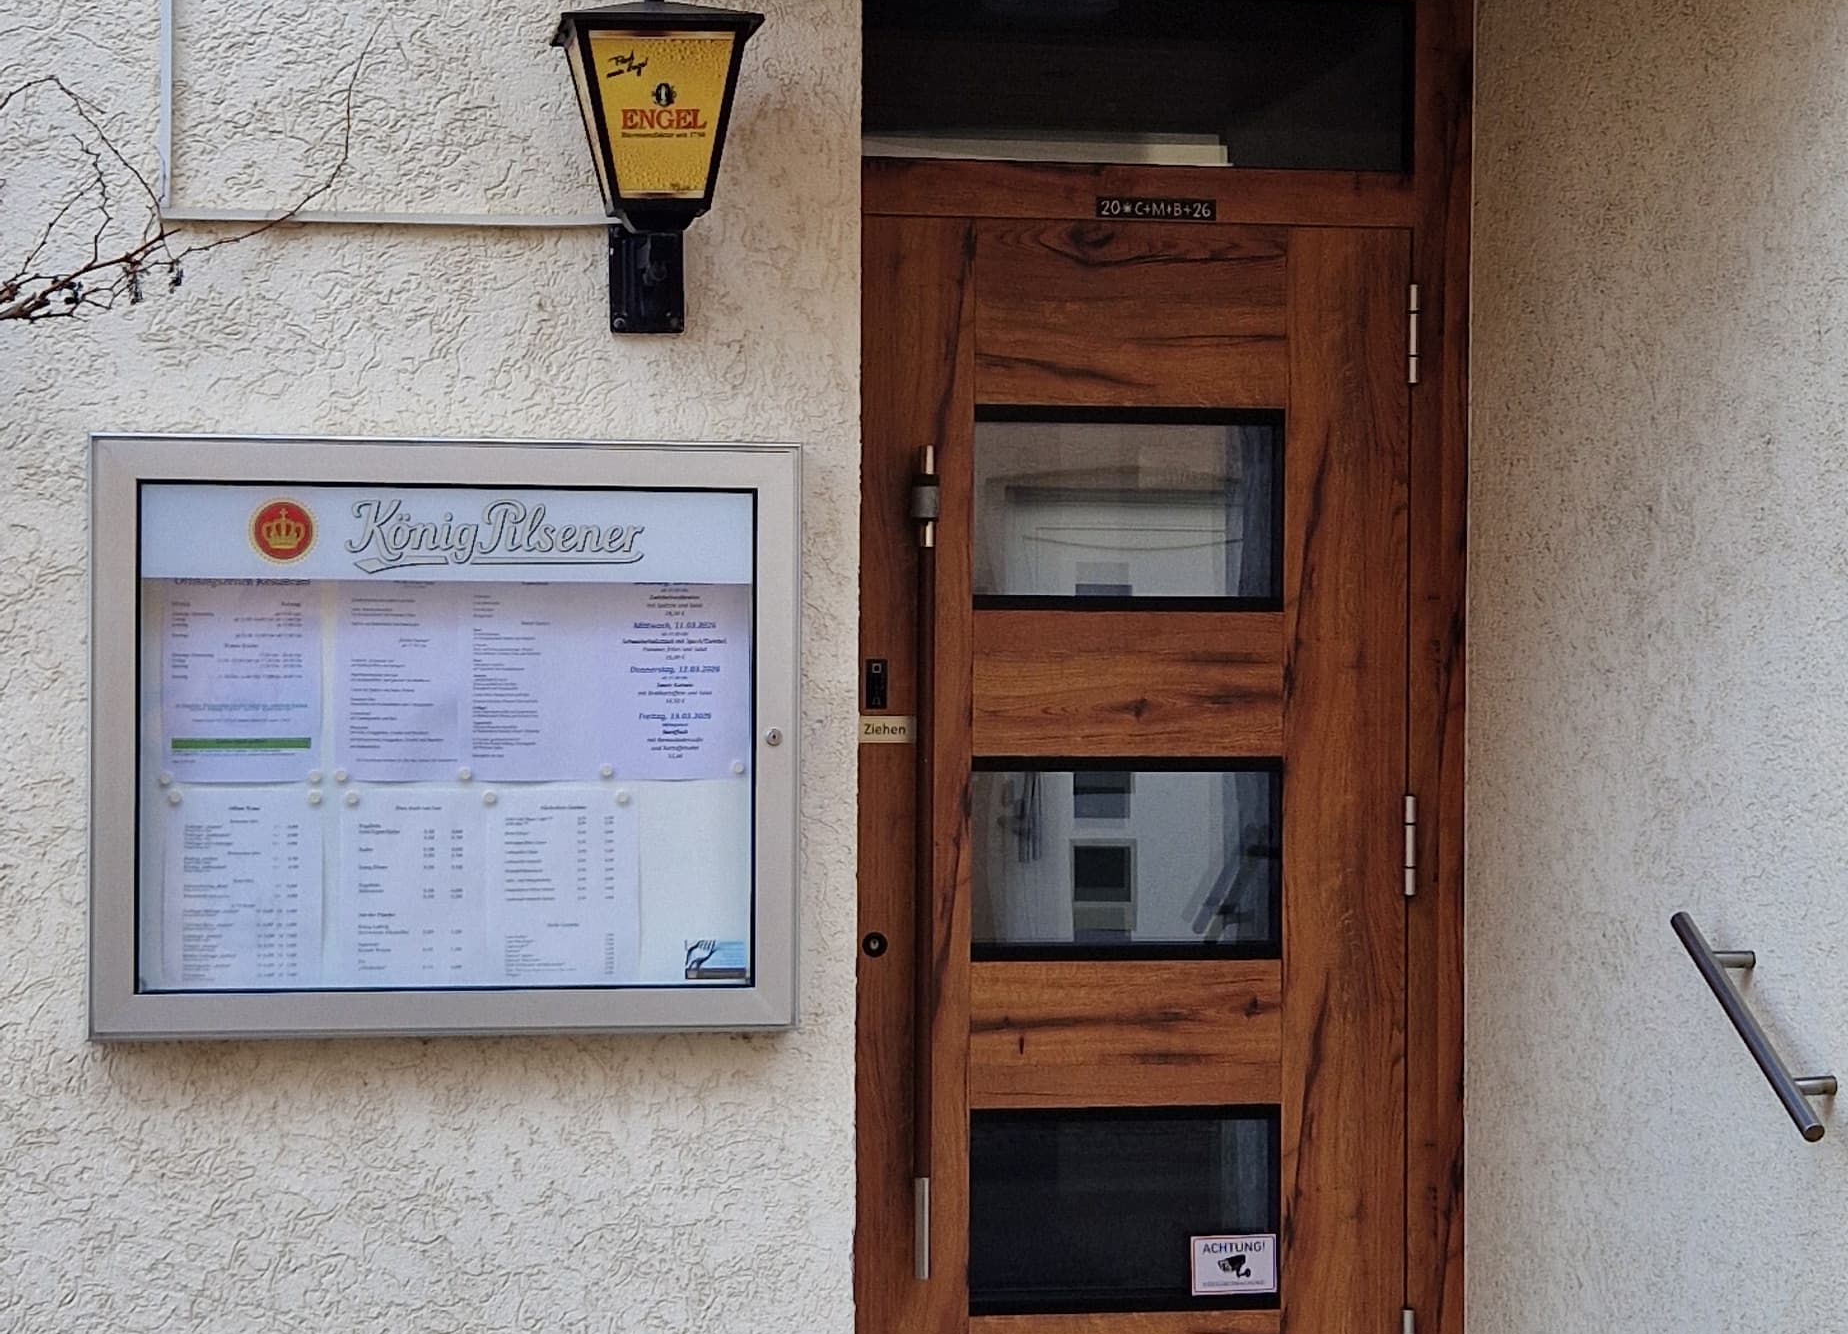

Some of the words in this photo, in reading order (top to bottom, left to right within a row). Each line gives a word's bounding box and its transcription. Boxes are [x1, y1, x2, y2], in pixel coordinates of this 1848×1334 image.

[621, 108, 708, 130] ENGEL
[344, 499, 478, 565] König
[476, 498, 646, 555] Pilsener
[863, 723, 906, 736] Ziehen
[1202, 1241, 1266, 1255] ACHTUNG!
